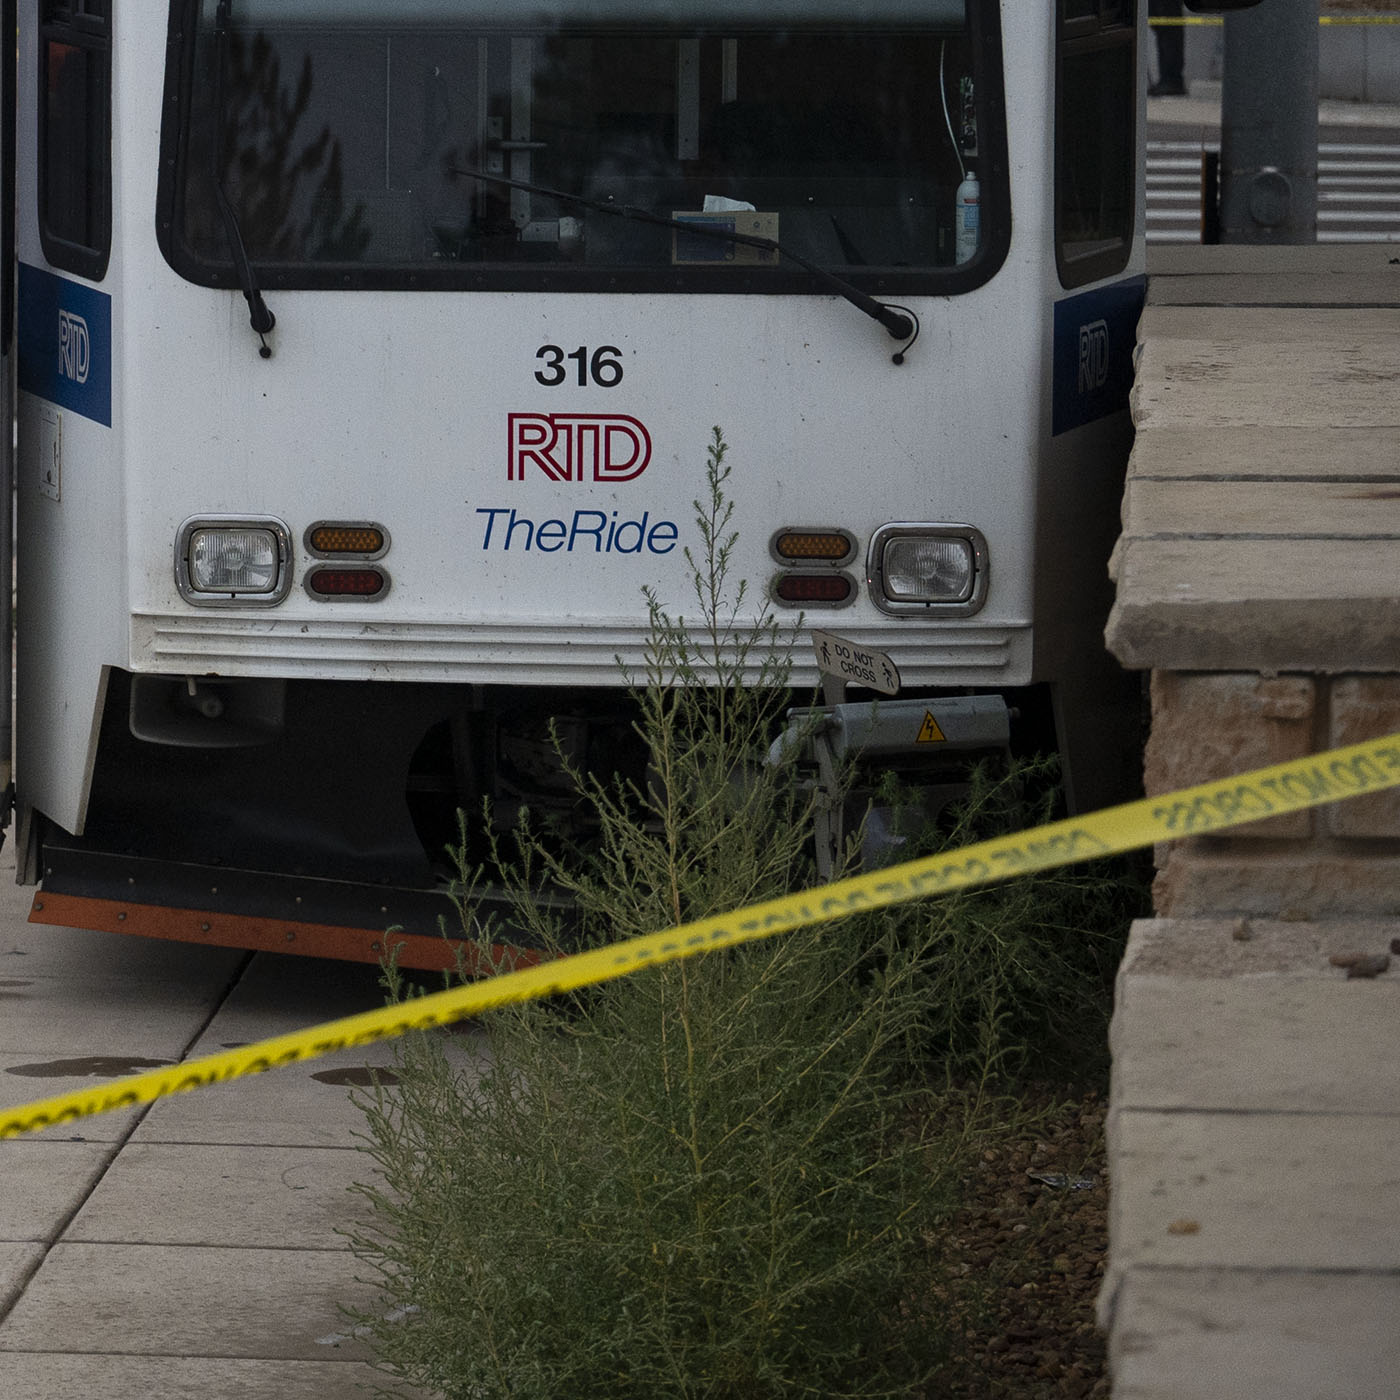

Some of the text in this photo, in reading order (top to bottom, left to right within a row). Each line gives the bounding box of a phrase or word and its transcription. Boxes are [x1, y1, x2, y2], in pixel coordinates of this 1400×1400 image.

[58, 308, 90, 384] RTD
[534, 344, 624, 388] 316
[1079, 319, 1109, 394] RTD
[507, 412, 652, 482] RTD
[475, 508, 679, 554] TheRide
[834, 644, 874, 668] DO NOT
[840, 660, 877, 683] CROSS
